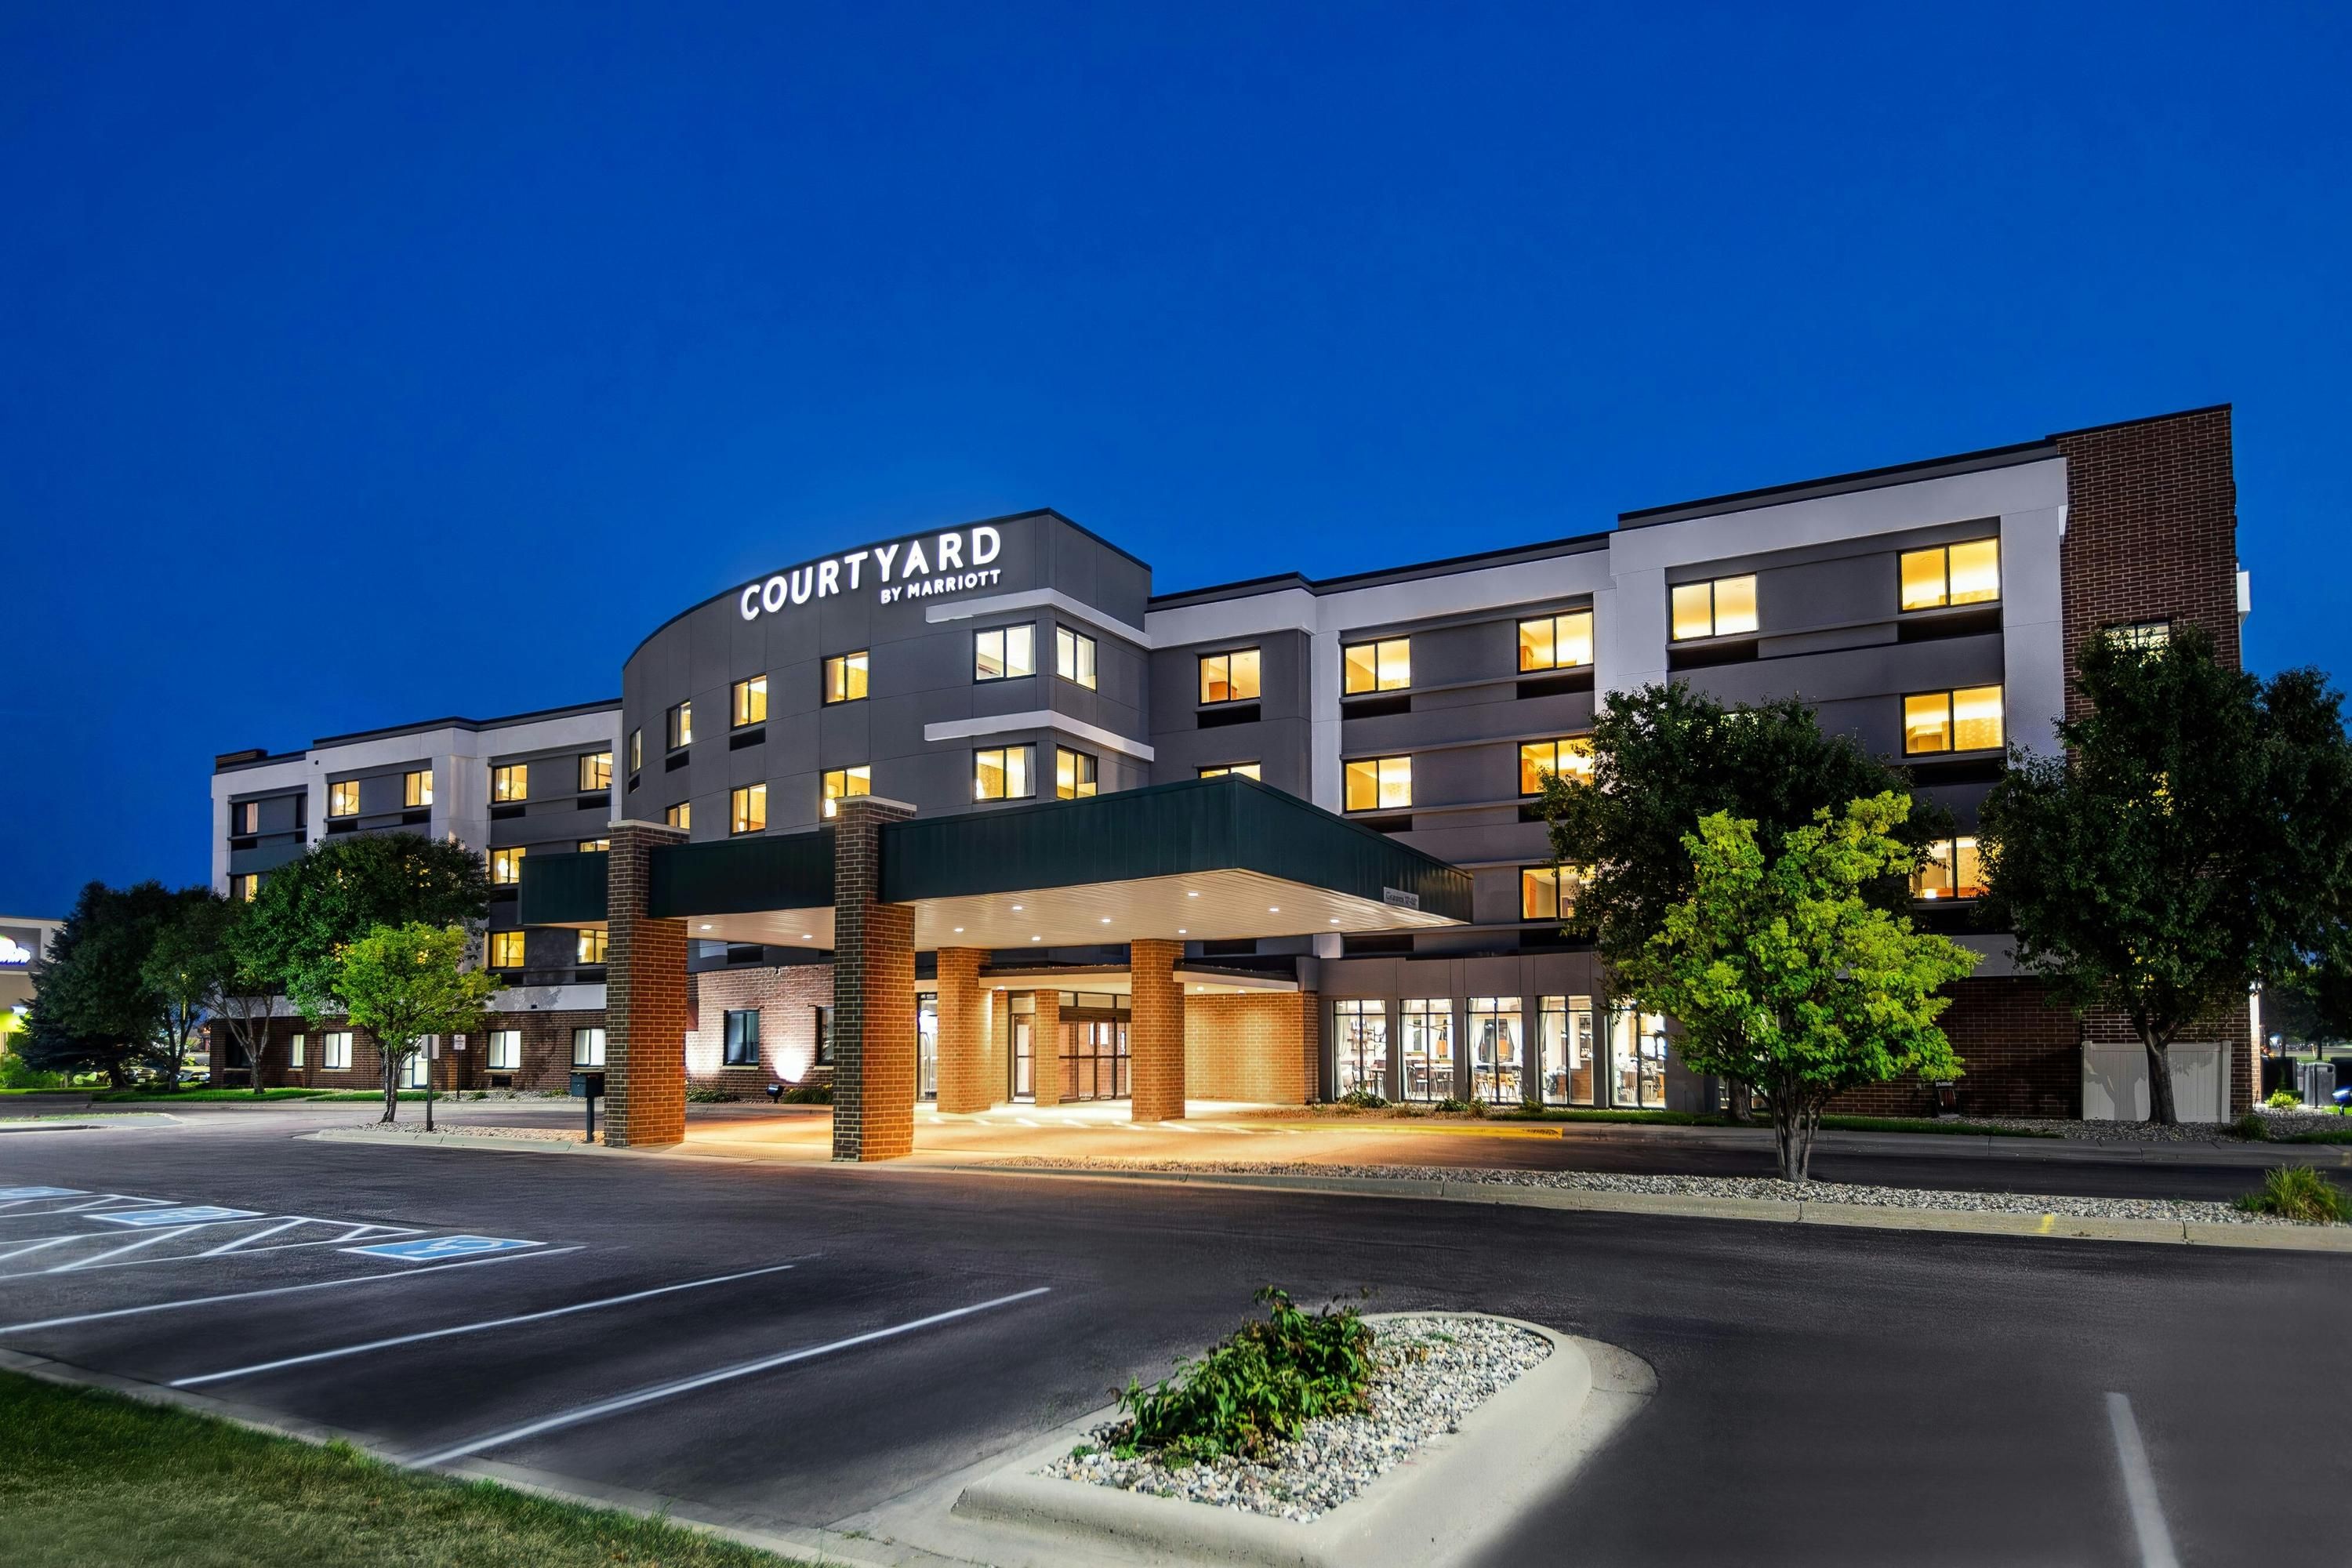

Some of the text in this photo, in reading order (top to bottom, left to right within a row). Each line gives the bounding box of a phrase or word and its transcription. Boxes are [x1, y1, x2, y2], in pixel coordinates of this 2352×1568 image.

[740, 526, 1001, 621] COURTYARD
[880, 569, 1001, 604] BY MARRIOTT
